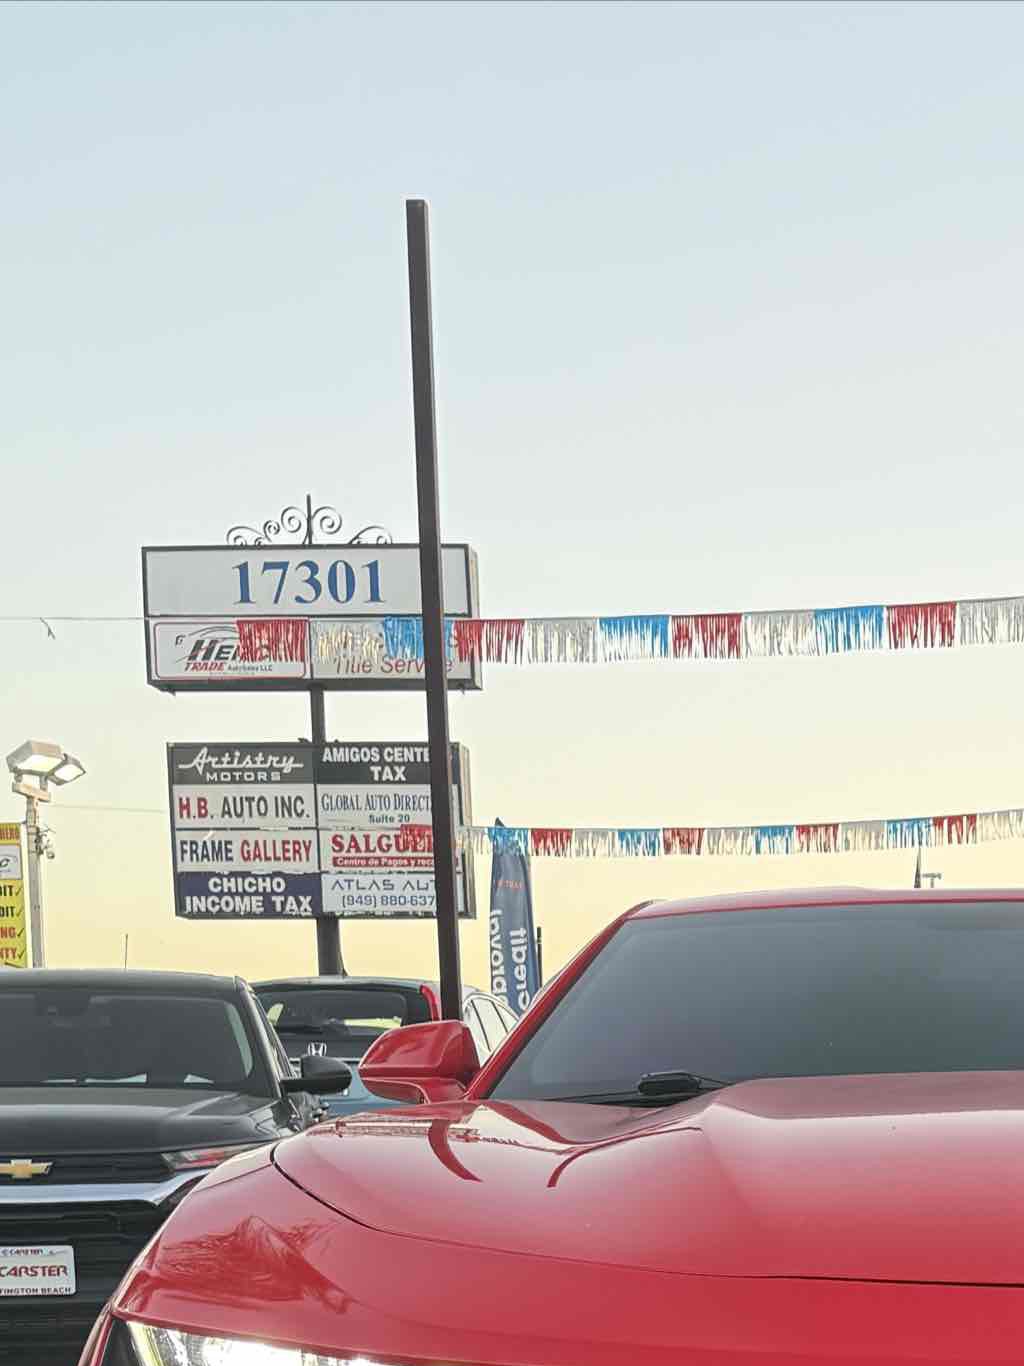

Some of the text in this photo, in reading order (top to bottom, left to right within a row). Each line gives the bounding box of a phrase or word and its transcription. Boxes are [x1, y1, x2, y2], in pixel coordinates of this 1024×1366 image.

[231, 559, 387, 605] 17301
[184, 662, 226, 672] TRADE
[380, 654, 454, 675] Serve
[178, 747, 304, 773] Artistry
[322, 746, 380, 763] AMIGOS
[206, 772, 282, 782] MOTORS
[369, 765, 406, 782] TAX
[178, 795, 311, 820] H.B. AUTO INC.
[364, 793, 391, 812] AUTO
[179, 839, 312, 862] FRAME GALLERY
[208, 876, 287, 894] CHICHO
[331, 879, 394, 891] ATLAS
[184, 895, 313, 915] INCOME TAX
[0, 1264, 68, 1278] CARSTER
[41, 1287, 71, 1296] BEACH
